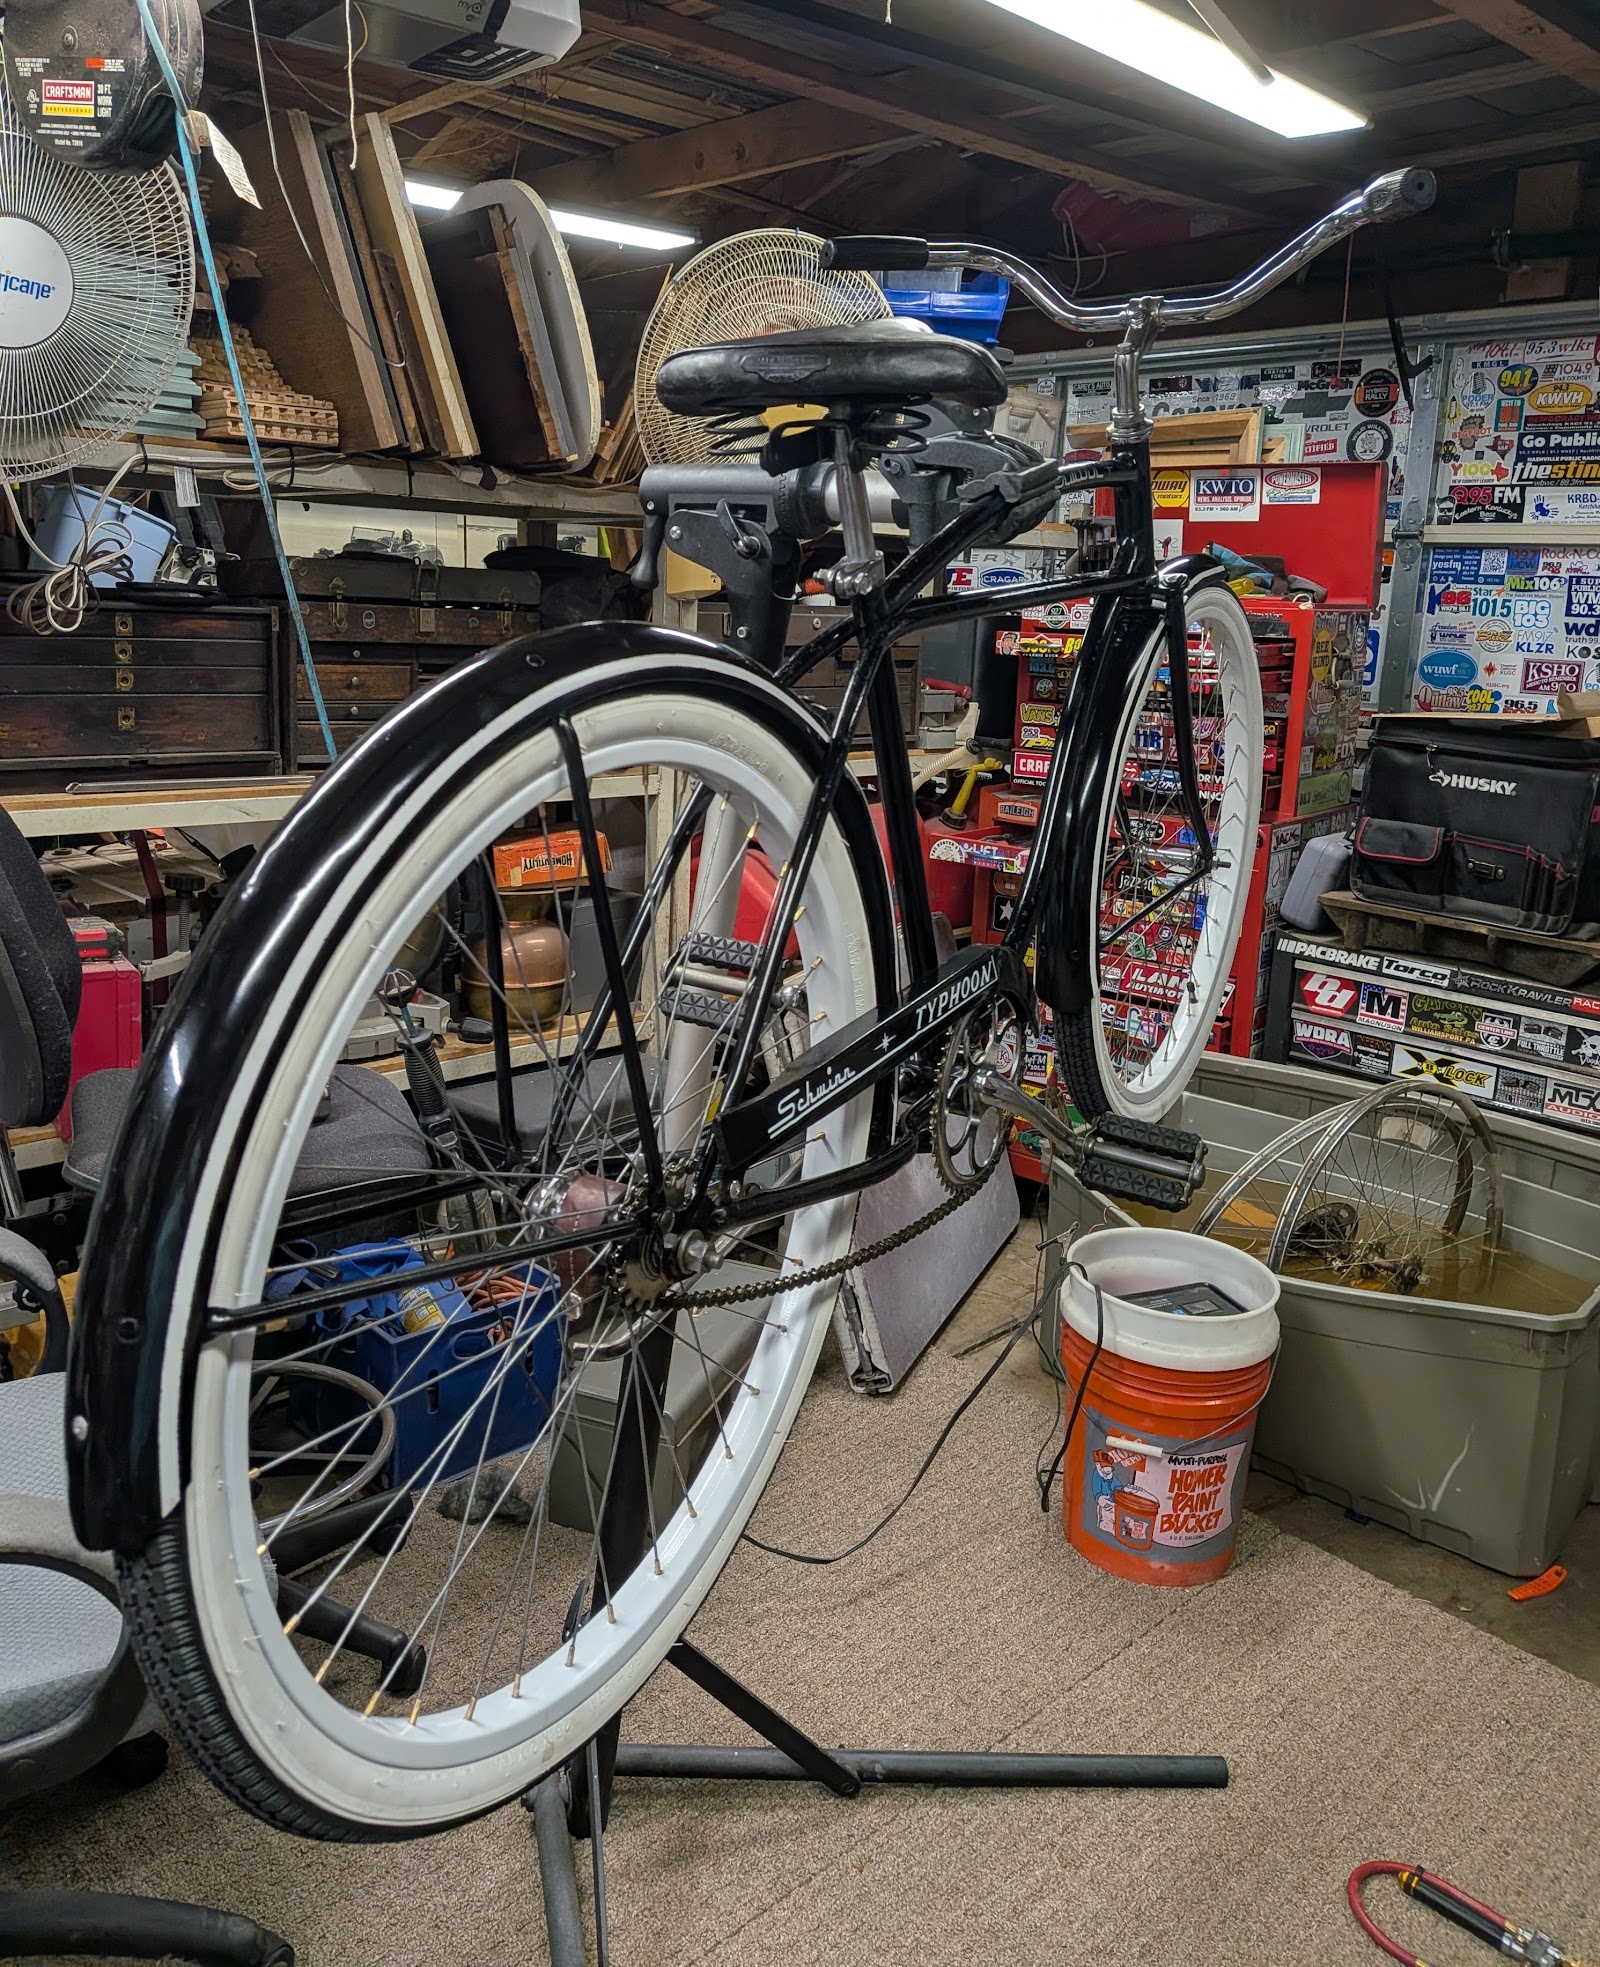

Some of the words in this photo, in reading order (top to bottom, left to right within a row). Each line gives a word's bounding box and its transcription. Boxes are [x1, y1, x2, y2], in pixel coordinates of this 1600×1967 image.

[45, 85, 91, 99] CRAFTSMAN
[97, 84, 104, 94] 30
[97, 95, 112, 106] WORK
[45, 105, 91, 113] PROFESSIONAL
[97, 107, 112, 117] LIGHT
[1526, 341, 1557, 355] 95.3
[1559, 338, 1594, 353] wlkr
[1560, 364, 1592, 375] 104.9
[1500, 369, 1533, 387] 94.1
[1192, 395, 1209, 403] Since
[1215, 393, 1236, 401] 1969
[1462, 394, 1494, 402] PODER
[1536, 392, 1583, 405] KWVH
[1352, 426, 1366, 441] WILD
[1367, 424, 1389, 440] WILLIES
[1451, 427, 1492, 439] BIGFOOT
[1522, 435, 1546, 448] Go
[1451, 462, 1492, 477] Y100
[1271, 471, 1312, 485] POWERMASTER
[1199, 479, 1254, 495] KWTO
[1451, 486, 1493, 504] Q95
[1494, 487, 1521, 503] FM
[1454, 505, 1482, 520] Eastern
[1480, 510, 1496, 518] Best
[1473, 587, 1493, 597] Star
[1471, 598, 1512, 617] 101.5
[1515, 600, 1551, 615] BIG
[1316, 641, 1329, 654] BEE
[1516, 641, 1555, 654] KLZR
[1312, 655, 1330, 669] KIND
[1423, 664, 1459, 675] wuwf
[1527, 661, 1579, 683] KSHO
[1550, 681, 1576, 692] 90
[1467, 689, 1495, 704] COOL
[1482, 703, 1492, 711] FM
[1505, 699, 1537, 710] 96.5
[1013, 778, 1035, 786] OFFICIAL
[1451, 774, 1517, 796] HUSKY
[1000, 804, 1035, 818] BAILEIGH
[973, 844, 998, 856] LIFT
[1294, 942, 1380, 971] PACBRAKE
[915, 960, 993, 1031] TYPHOON
[1412, 994, 1483, 1020] GATORS
[1357, 1016, 1404, 1033] MAGNUSON
[1409, 1016, 1440, 1030] Auto
[1443, 1024, 1480, 1040] Sales
[1478, 1024, 1499, 1033] CENTER
[1500, 1028, 1514, 1036] LINE
[1295, 1021, 1350, 1048] WDRA
[1517, 1039, 1532, 1050] FULL
[1534, 1041, 1565, 1057] THROTTLE
[1444, 1066, 1494, 1088] LOCK
[770, 1066, 856, 1134] Schwinn
[1168, 1454, 1228, 1466] MULTI-PURPOSE
[1168, 1463, 1228, 1493] HOMER
[1172, 1487, 1221, 1514] PAINT
[1159, 1508, 1224, 1534] BUCKET
